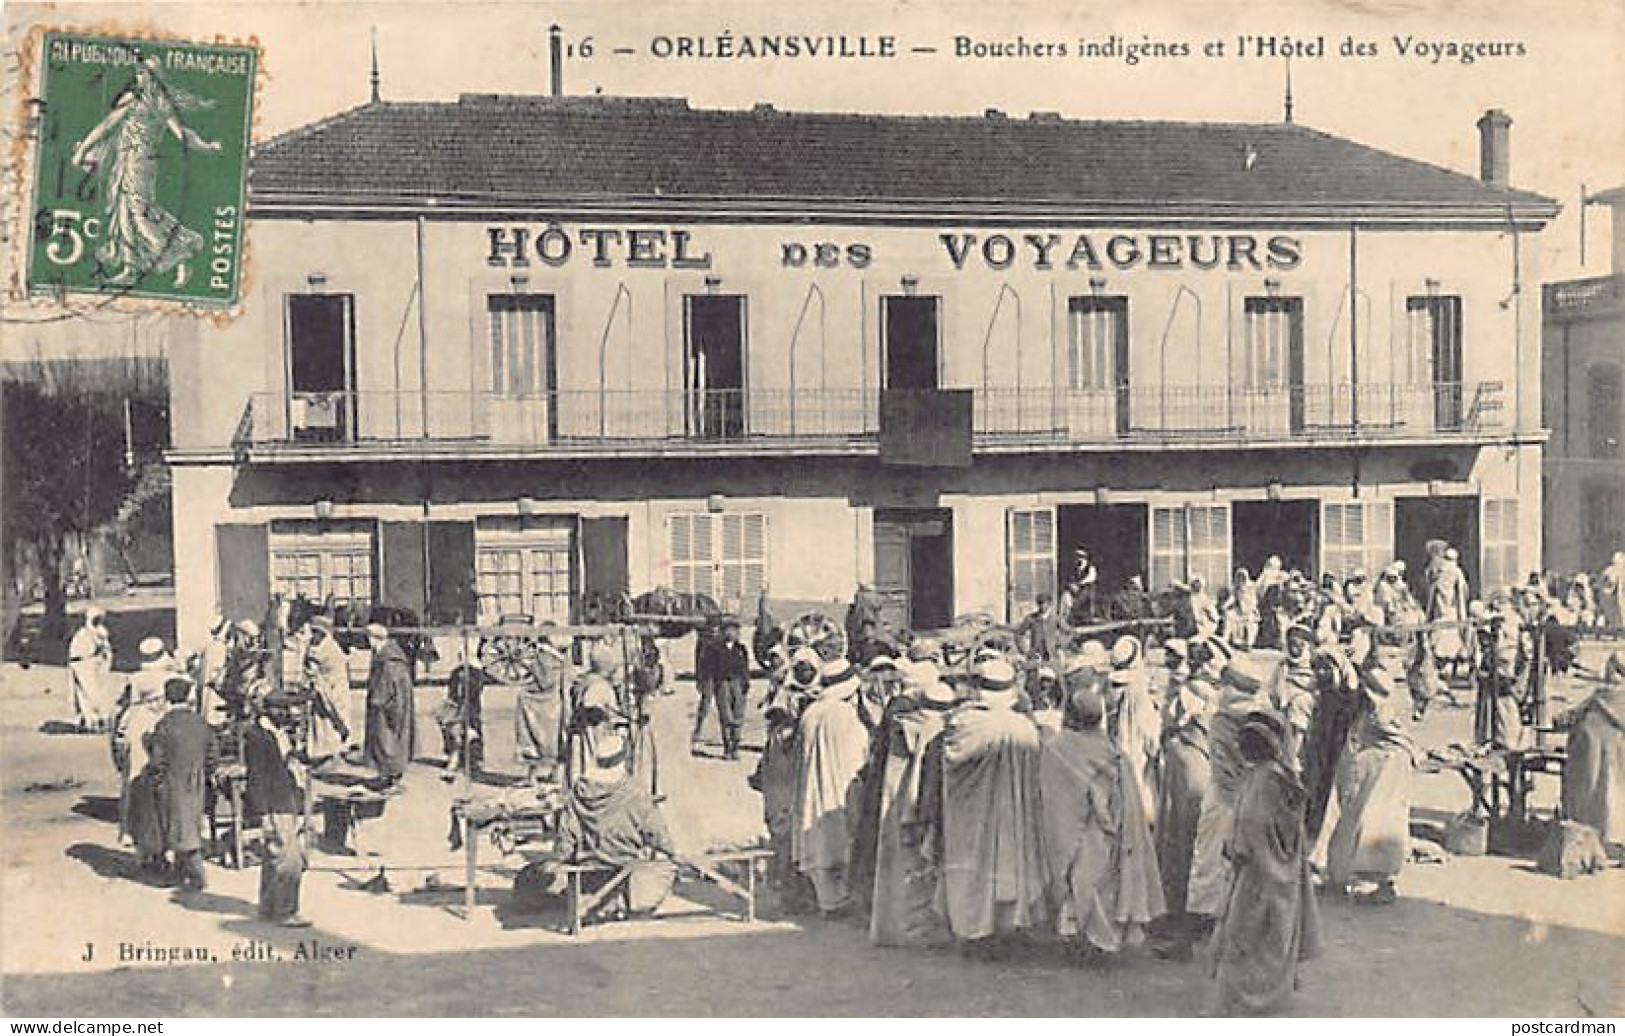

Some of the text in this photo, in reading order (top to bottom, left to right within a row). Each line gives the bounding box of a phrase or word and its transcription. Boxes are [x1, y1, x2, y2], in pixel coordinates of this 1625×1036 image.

[210, 205, 237, 290] POSTES
[487, 221, 712, 269] HÔTEL
[939, 233, 1301, 270] VOYAGEURS
